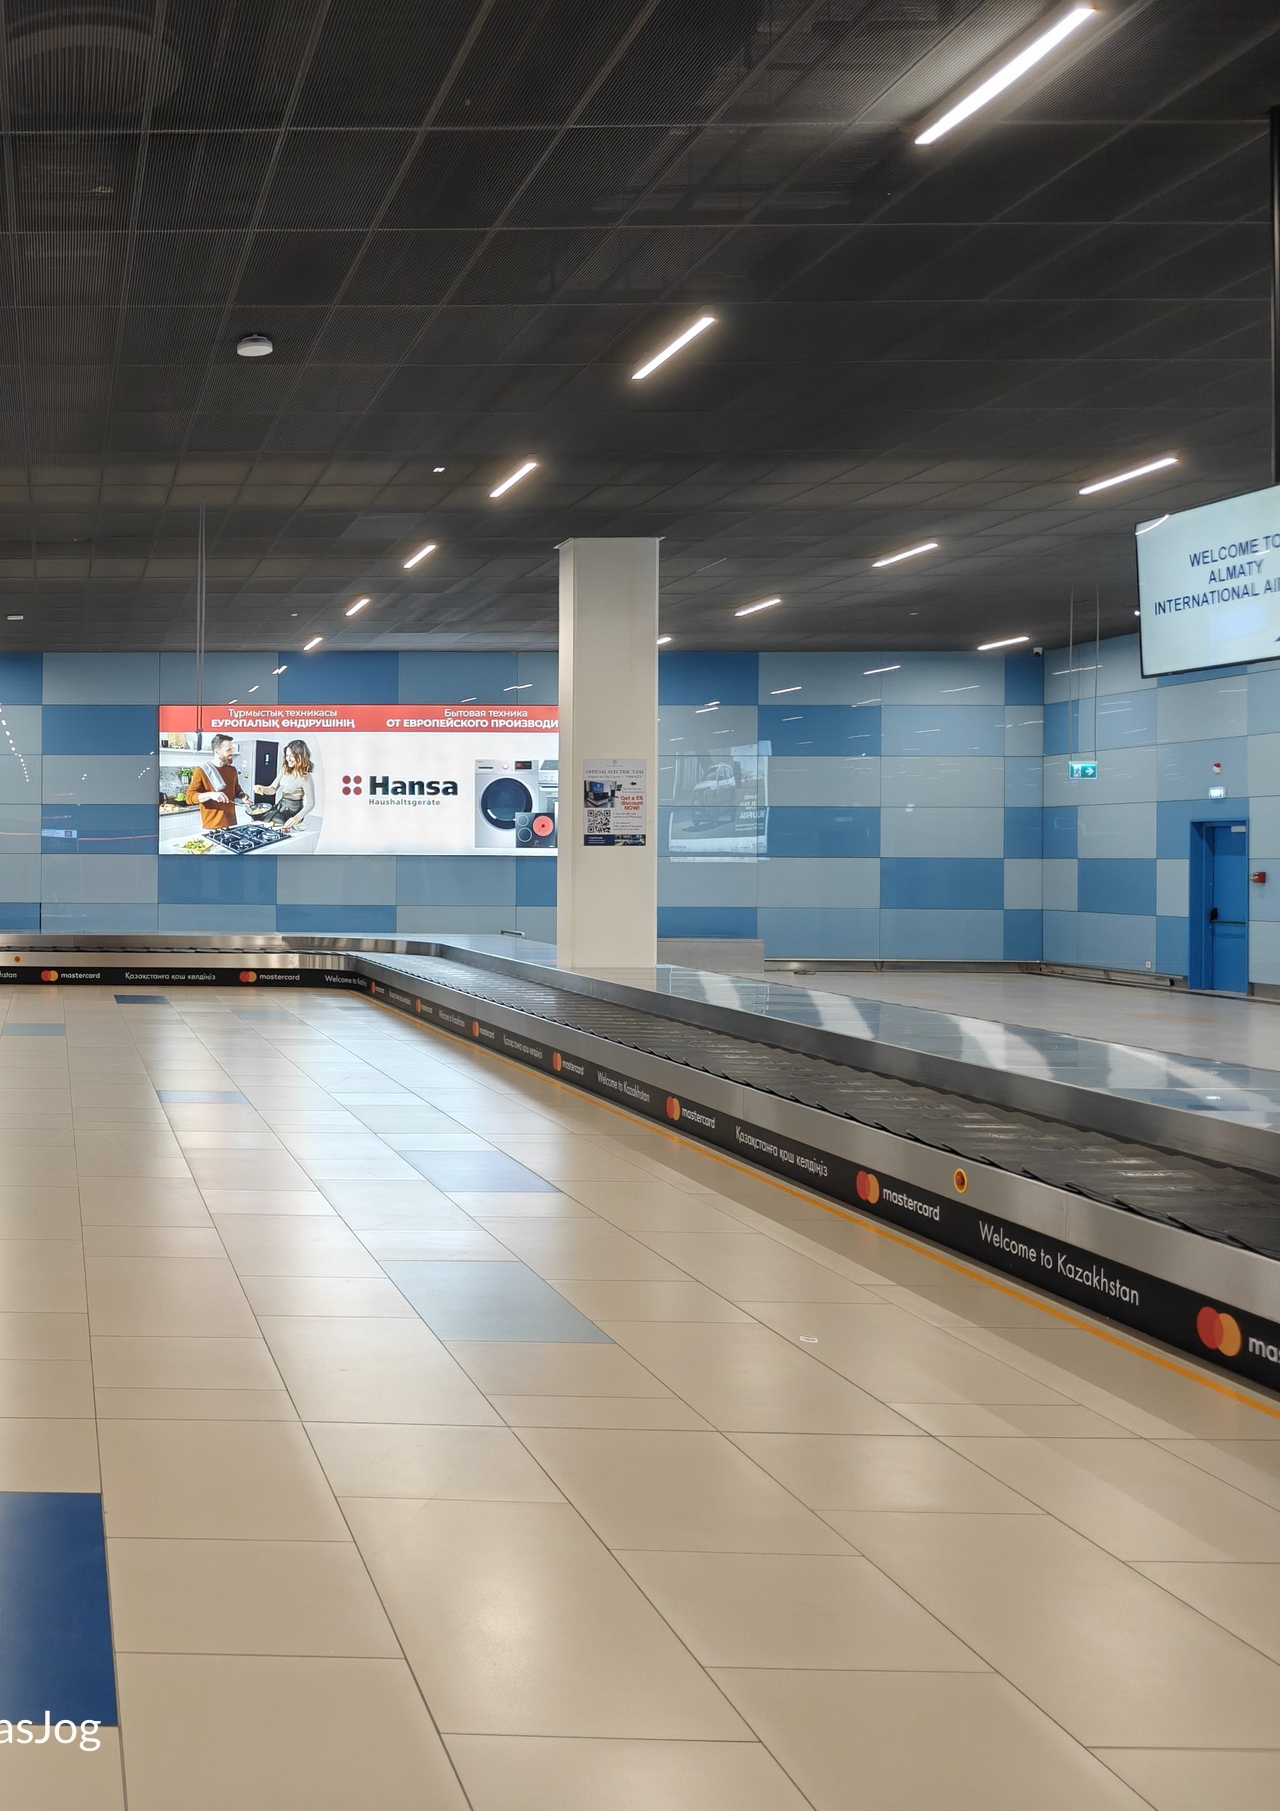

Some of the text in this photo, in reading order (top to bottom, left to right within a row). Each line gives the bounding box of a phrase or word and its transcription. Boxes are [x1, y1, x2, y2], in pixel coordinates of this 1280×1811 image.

[1189, 534, 1280, 567] WELCOME TO
[1208, 559, 1264, 584] ALMATY
[1154, 582, 1259, 616] INTERNATIONAL
[228, 708, 338, 718] Тұрмыстық техникасы
[444, 708, 528, 717] Бытовая техника
[211, 719, 355, 729] ЕУРОПАЛЫҚ ӨНДІРУШІНІҢ
[386, 718, 559, 729] ОТ ЕВРОПЕЙСКОГО ПРОИЗВОДИ
[369, 776, 458, 796] Hansa
[259, 973, 300, 981] mastercard
[324, 974, 352, 984] Welcome
[562, 1060, 585, 1075] mastercard
[597, 1071, 618, 1090] Welcome
[623, 1081, 650, 1103] Kazakhstan
[681, 1107, 715, 1129] mastercard
[779, 1148, 795, 1165] қош
[882, 1187, 940, 1221] mastercard
[978, 1220, 1139, 1306] Welcome to Kazakhstan
